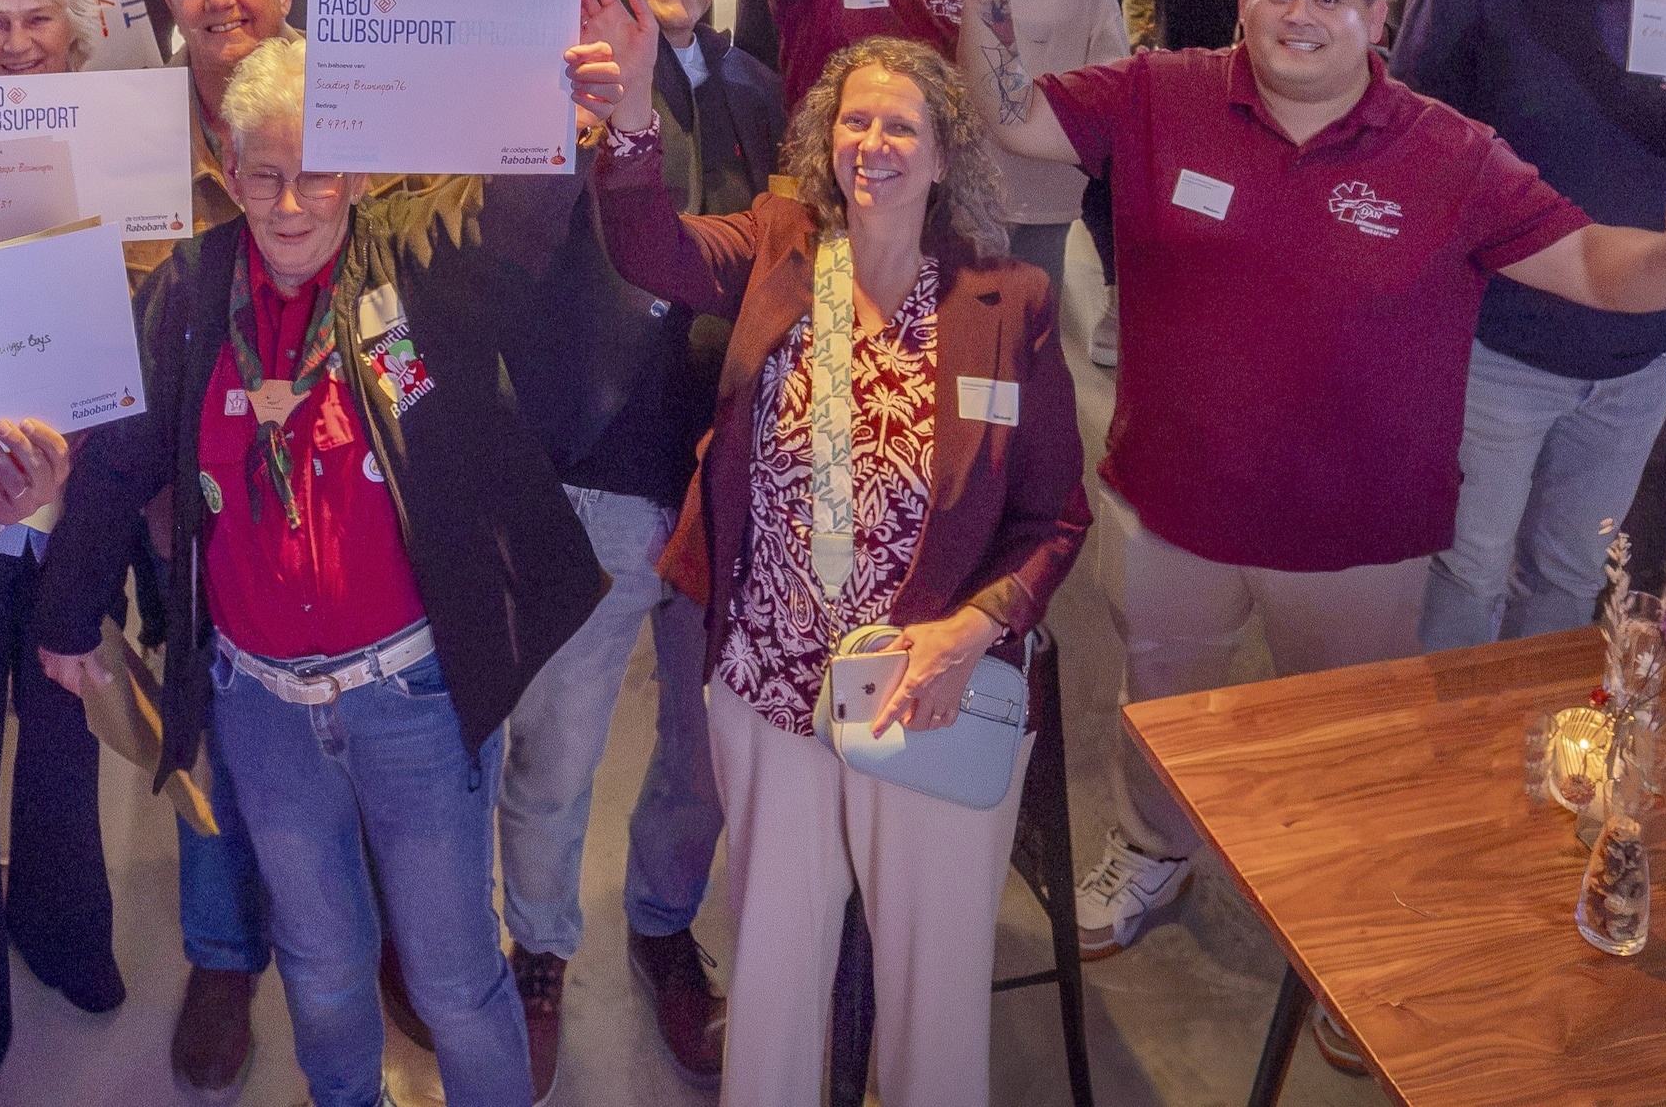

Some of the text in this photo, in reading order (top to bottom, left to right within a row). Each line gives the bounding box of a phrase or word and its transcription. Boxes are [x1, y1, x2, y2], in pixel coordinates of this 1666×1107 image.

[317, 17, 457, 45] CLUBSUPPORT
[501, 156, 548, 164] Rabobank
[125, 221, 169, 234] Rabobank
[71, 401, 118, 420] Rabobank
